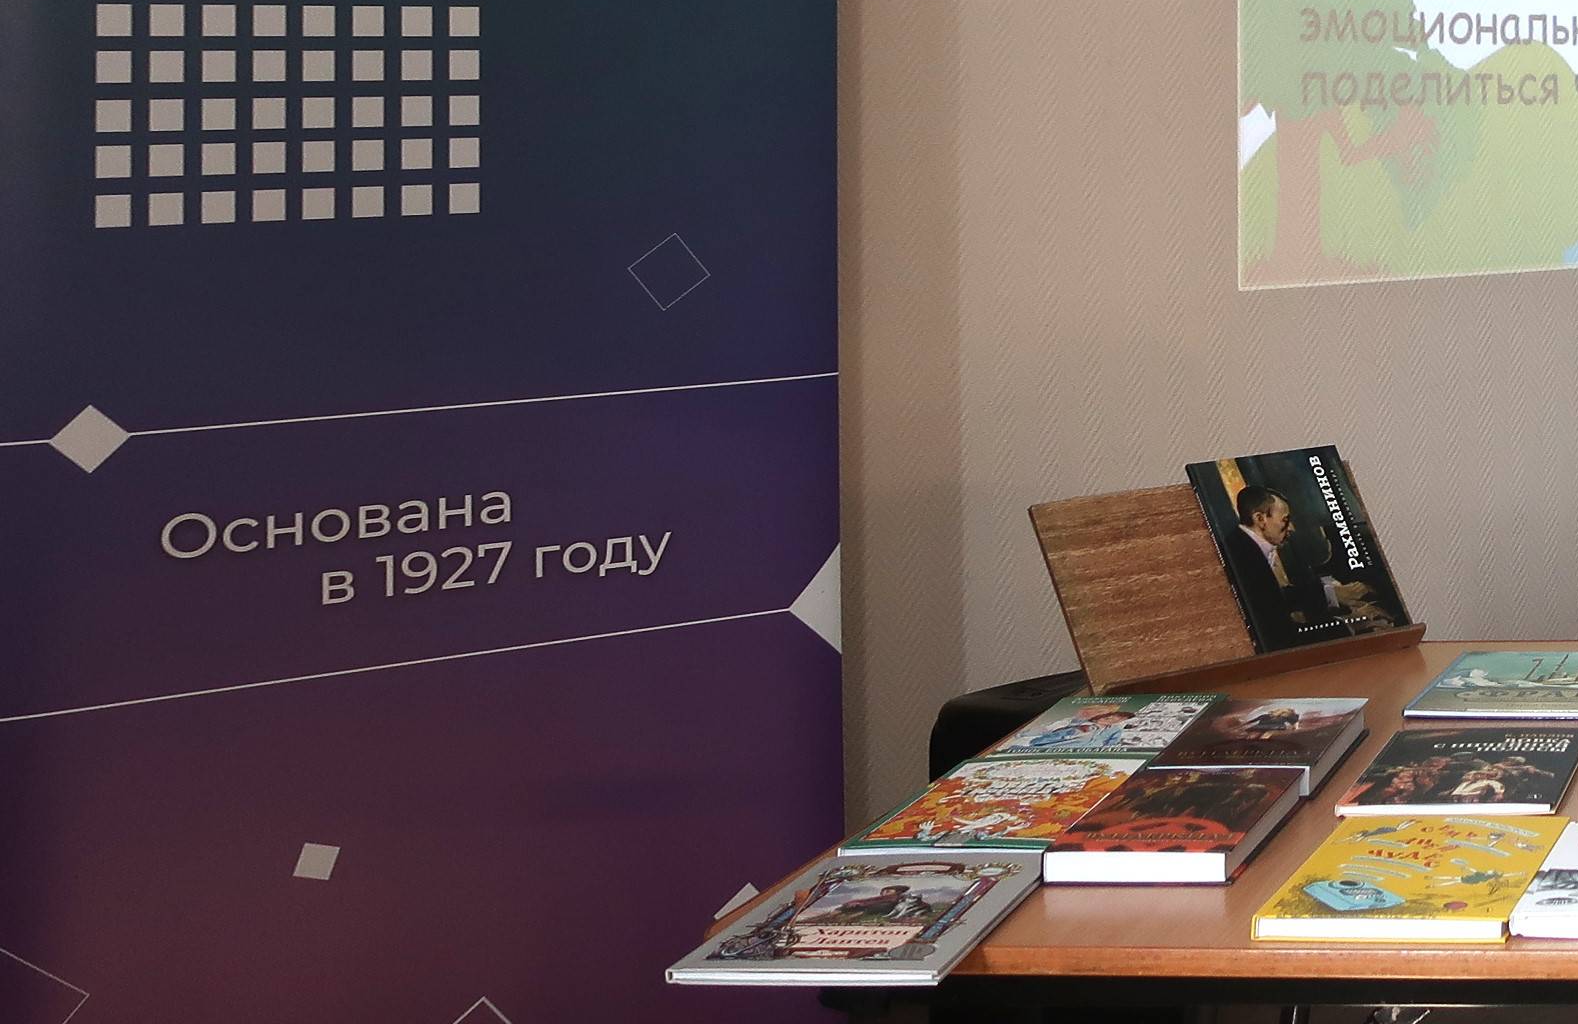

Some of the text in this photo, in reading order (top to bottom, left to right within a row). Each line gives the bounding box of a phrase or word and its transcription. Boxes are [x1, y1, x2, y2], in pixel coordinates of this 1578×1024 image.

[1300, 70, 1559, 111] поделиться
[161, 491, 512, 559] Основана
[1309, 454, 1366, 571] Рахманинов
[322, 531, 672, 605] в 1927 году
